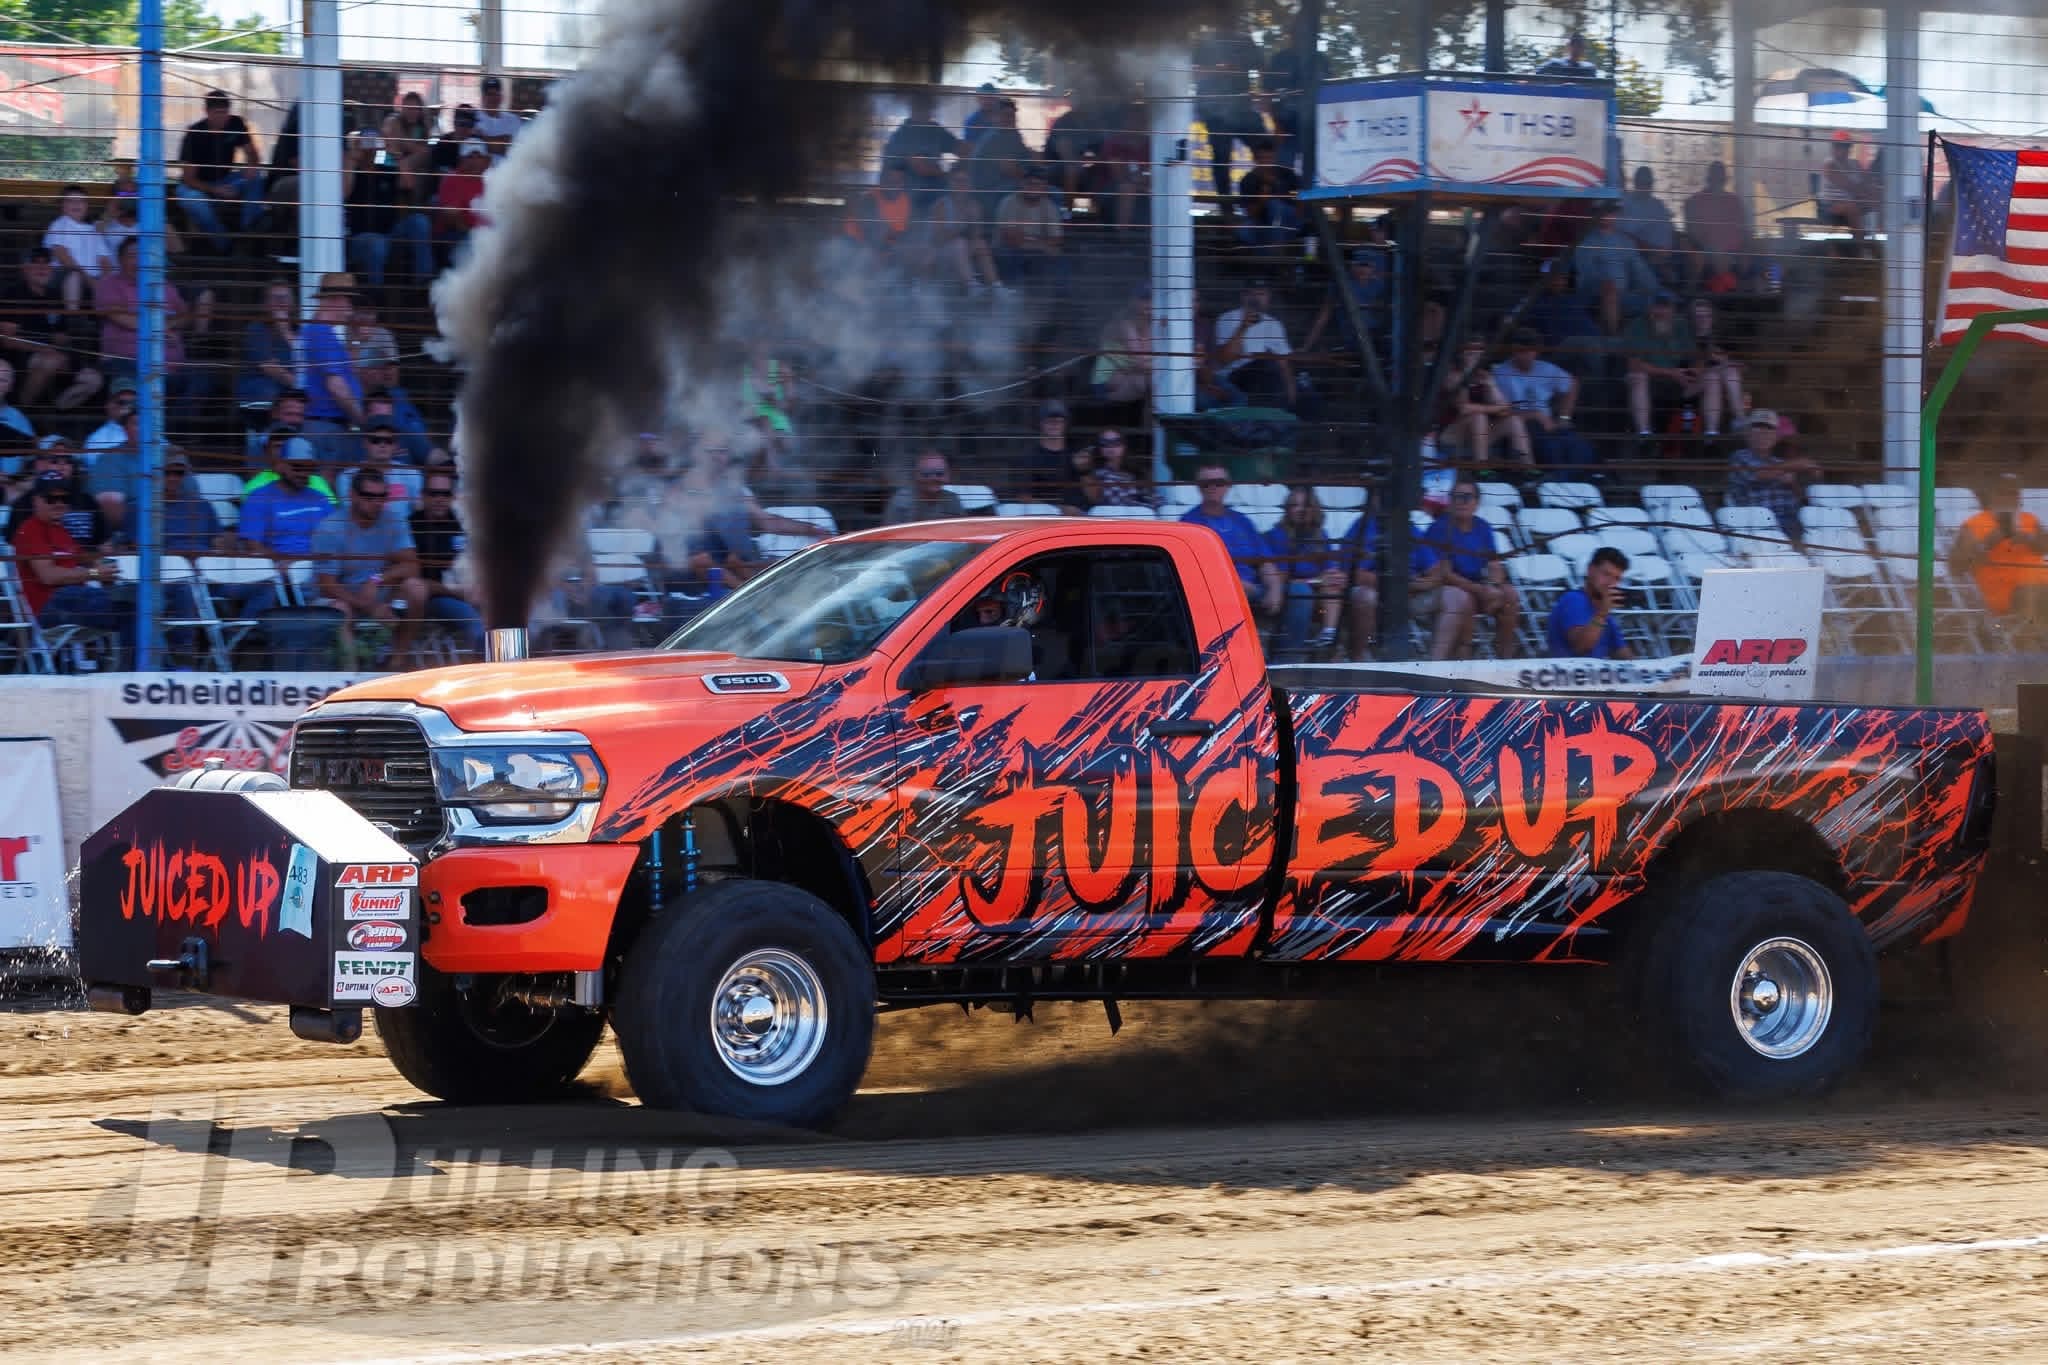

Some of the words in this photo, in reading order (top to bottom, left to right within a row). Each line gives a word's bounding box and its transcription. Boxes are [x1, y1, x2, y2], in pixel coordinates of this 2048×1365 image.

[1499, 112, 1577, 137] THSB
[1700, 638, 1807, 665] ARP
[718, 676, 772, 685] 3500
[1769, 668, 1807, 678] products
[122, 678, 353, 706] scheiddies
[960, 746, 1467, 927] JUICED
[1500, 706, 1657, 871] UP
[339, 865, 416, 884] ARP
[120, 836, 231, 941] JUICED
[237, 847, 280, 942] UP
[338, 960, 411, 975] FENDT
[345, 983, 369, 991] OPTIMA
